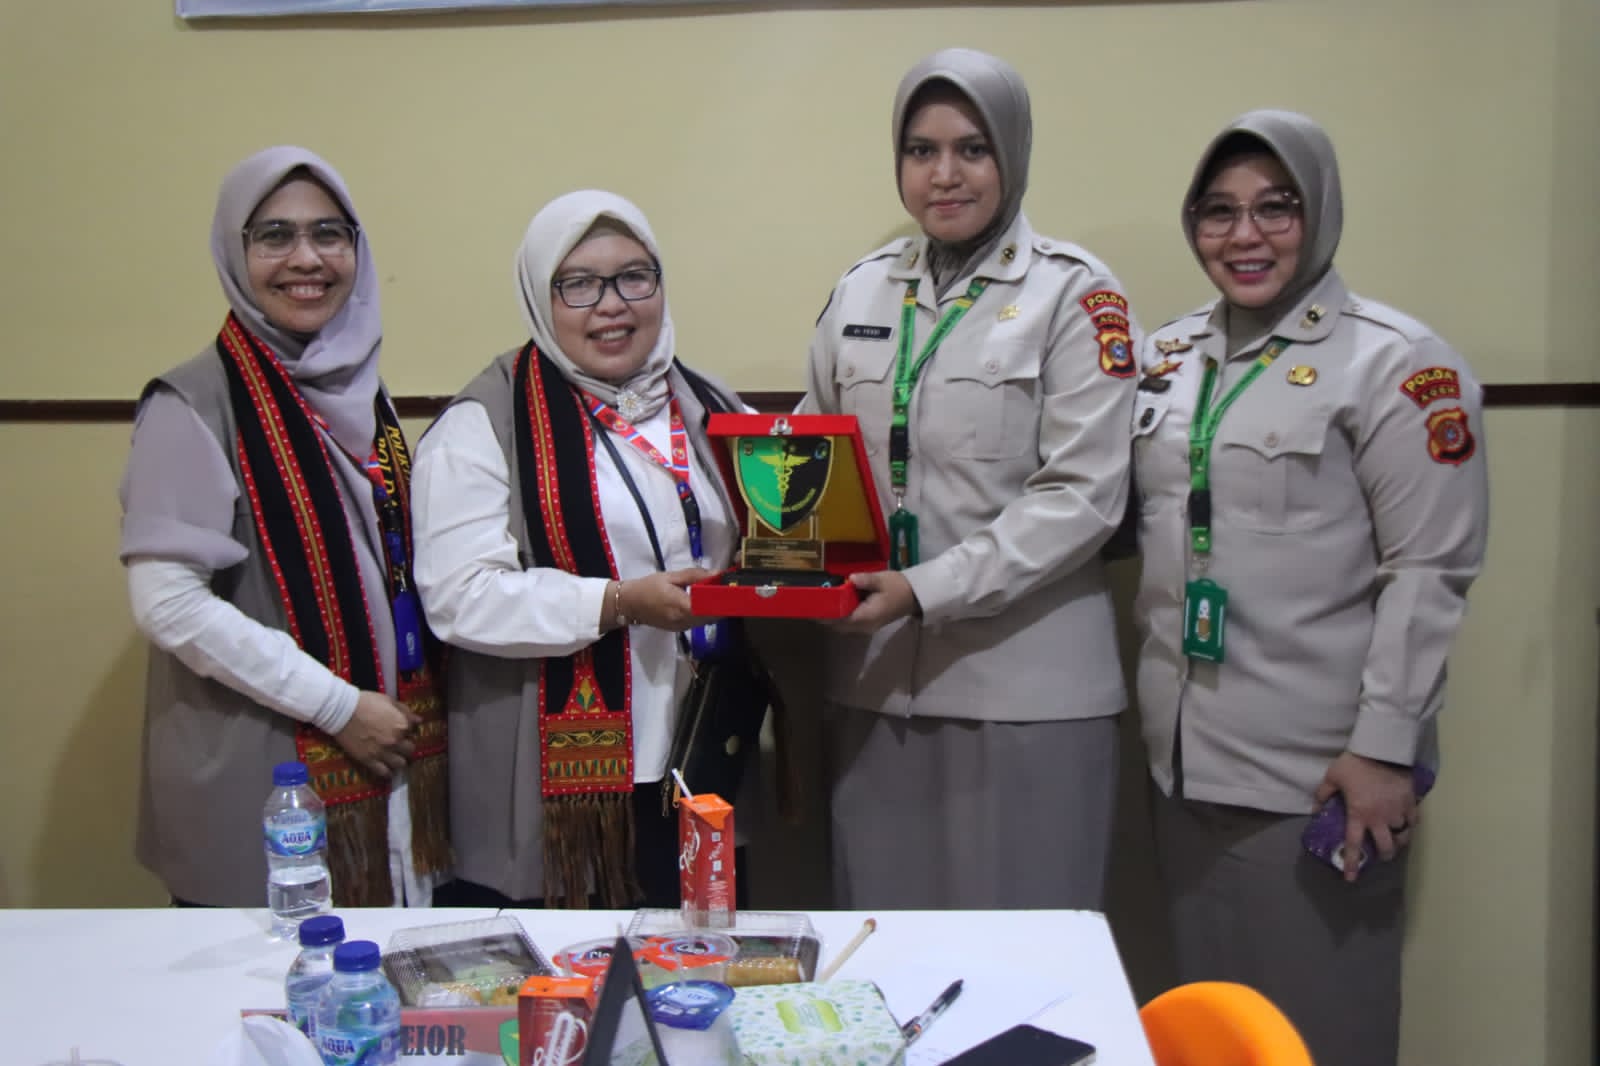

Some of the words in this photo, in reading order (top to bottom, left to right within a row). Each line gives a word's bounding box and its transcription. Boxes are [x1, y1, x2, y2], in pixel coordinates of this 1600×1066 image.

[1086, 294, 1125, 308] POLDA
[1405, 369, 1454, 393] POLDA
[282, 831, 312, 845] AQUA
[321, 1036, 355, 1056] AQUA
